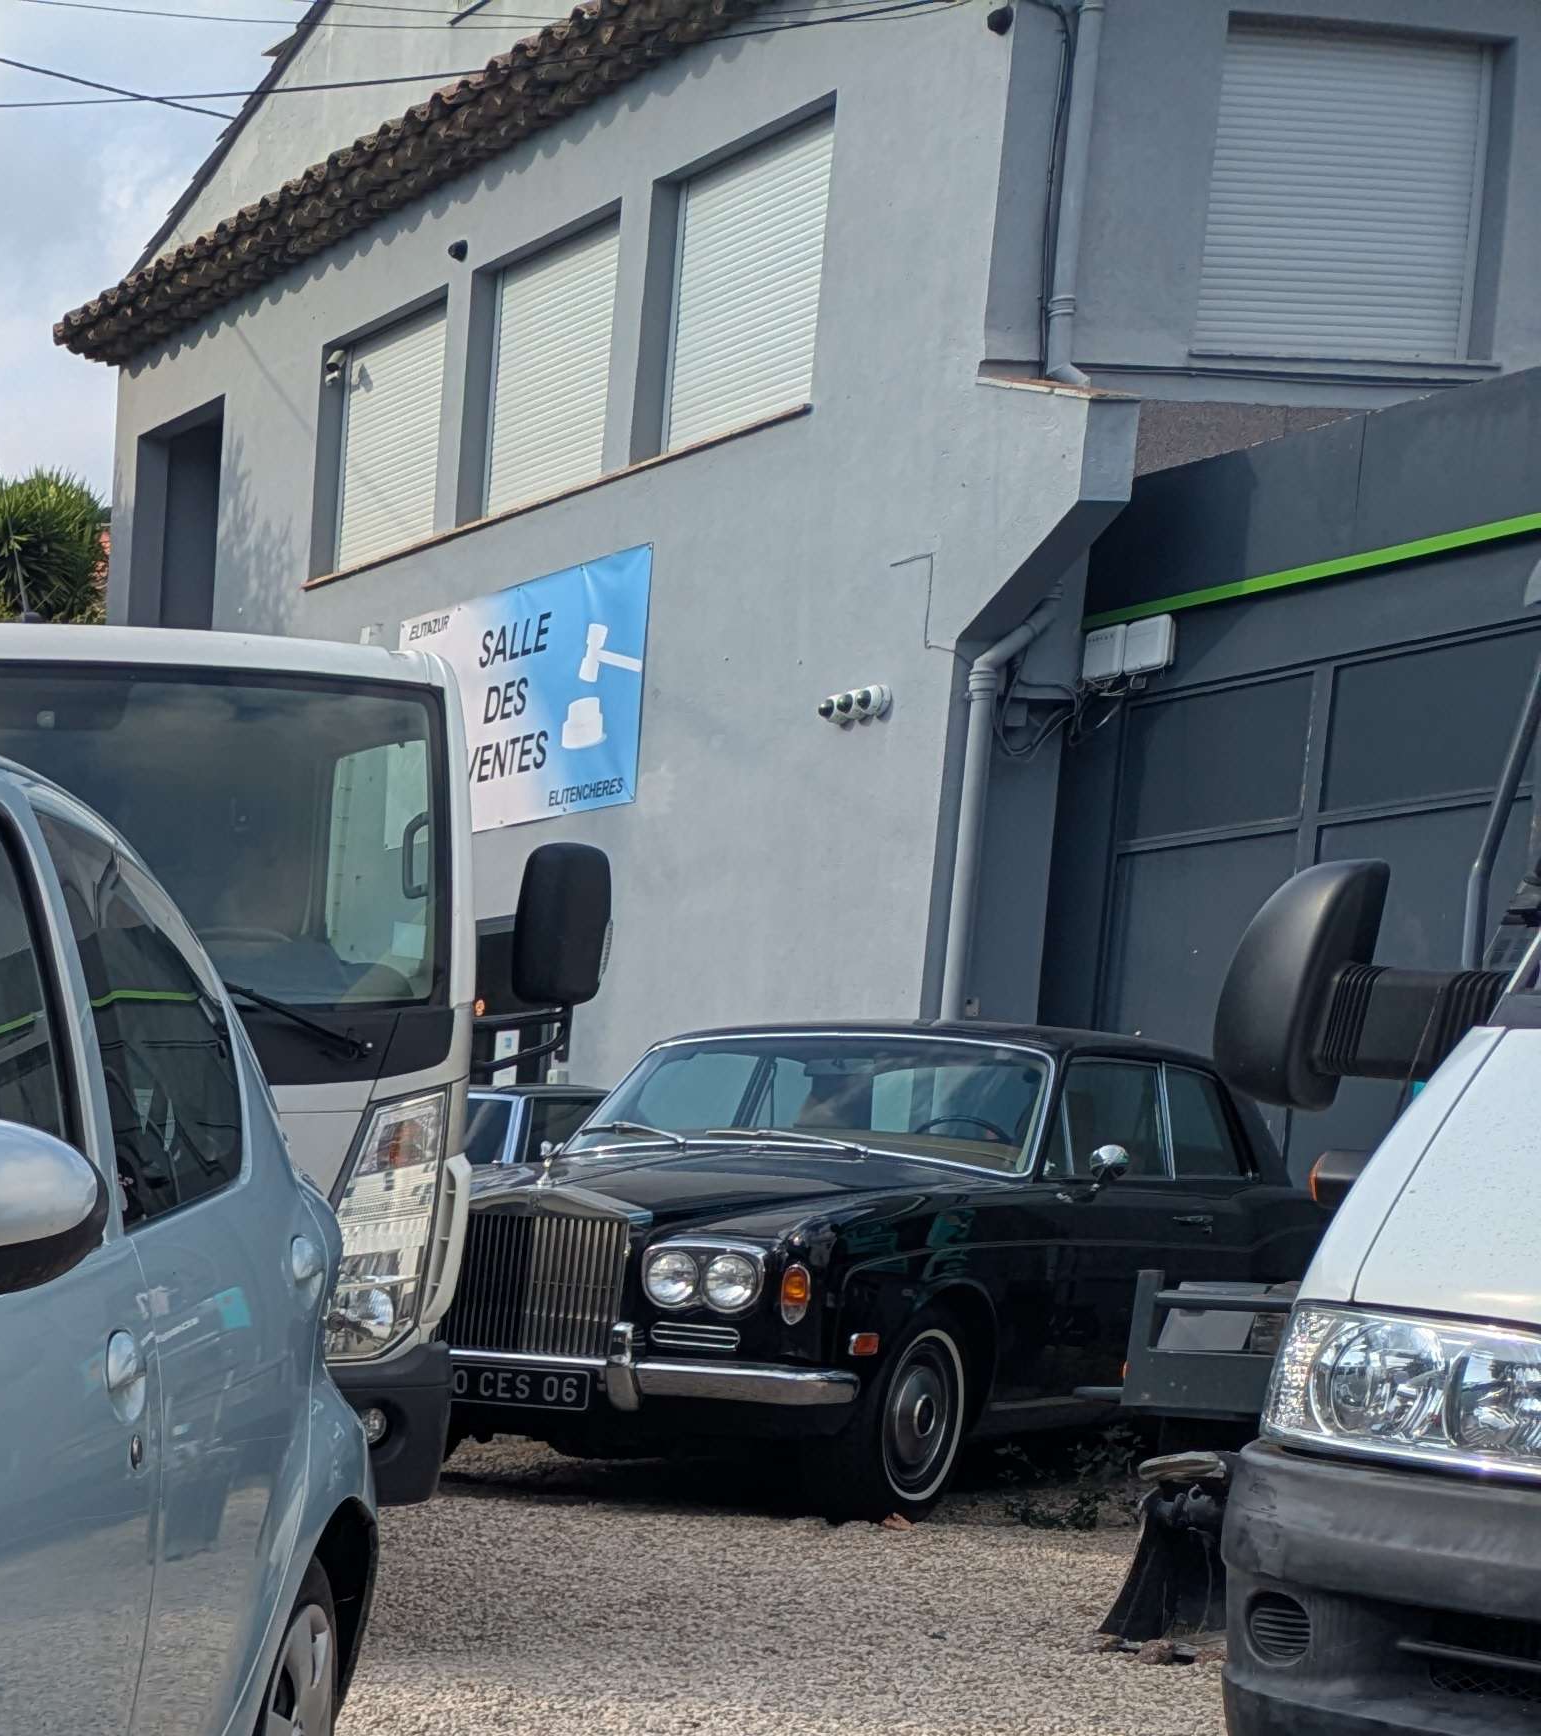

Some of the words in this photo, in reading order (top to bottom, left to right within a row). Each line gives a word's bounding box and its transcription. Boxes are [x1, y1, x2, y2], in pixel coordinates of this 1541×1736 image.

[478, 611, 552, 668] SALLE
[483, 676, 528, 725] DES
[548, 777, 624, 807] ELITENCHERES
[479, 1371, 531, 1399] CES
[542, 1376, 579, 1403] 06
